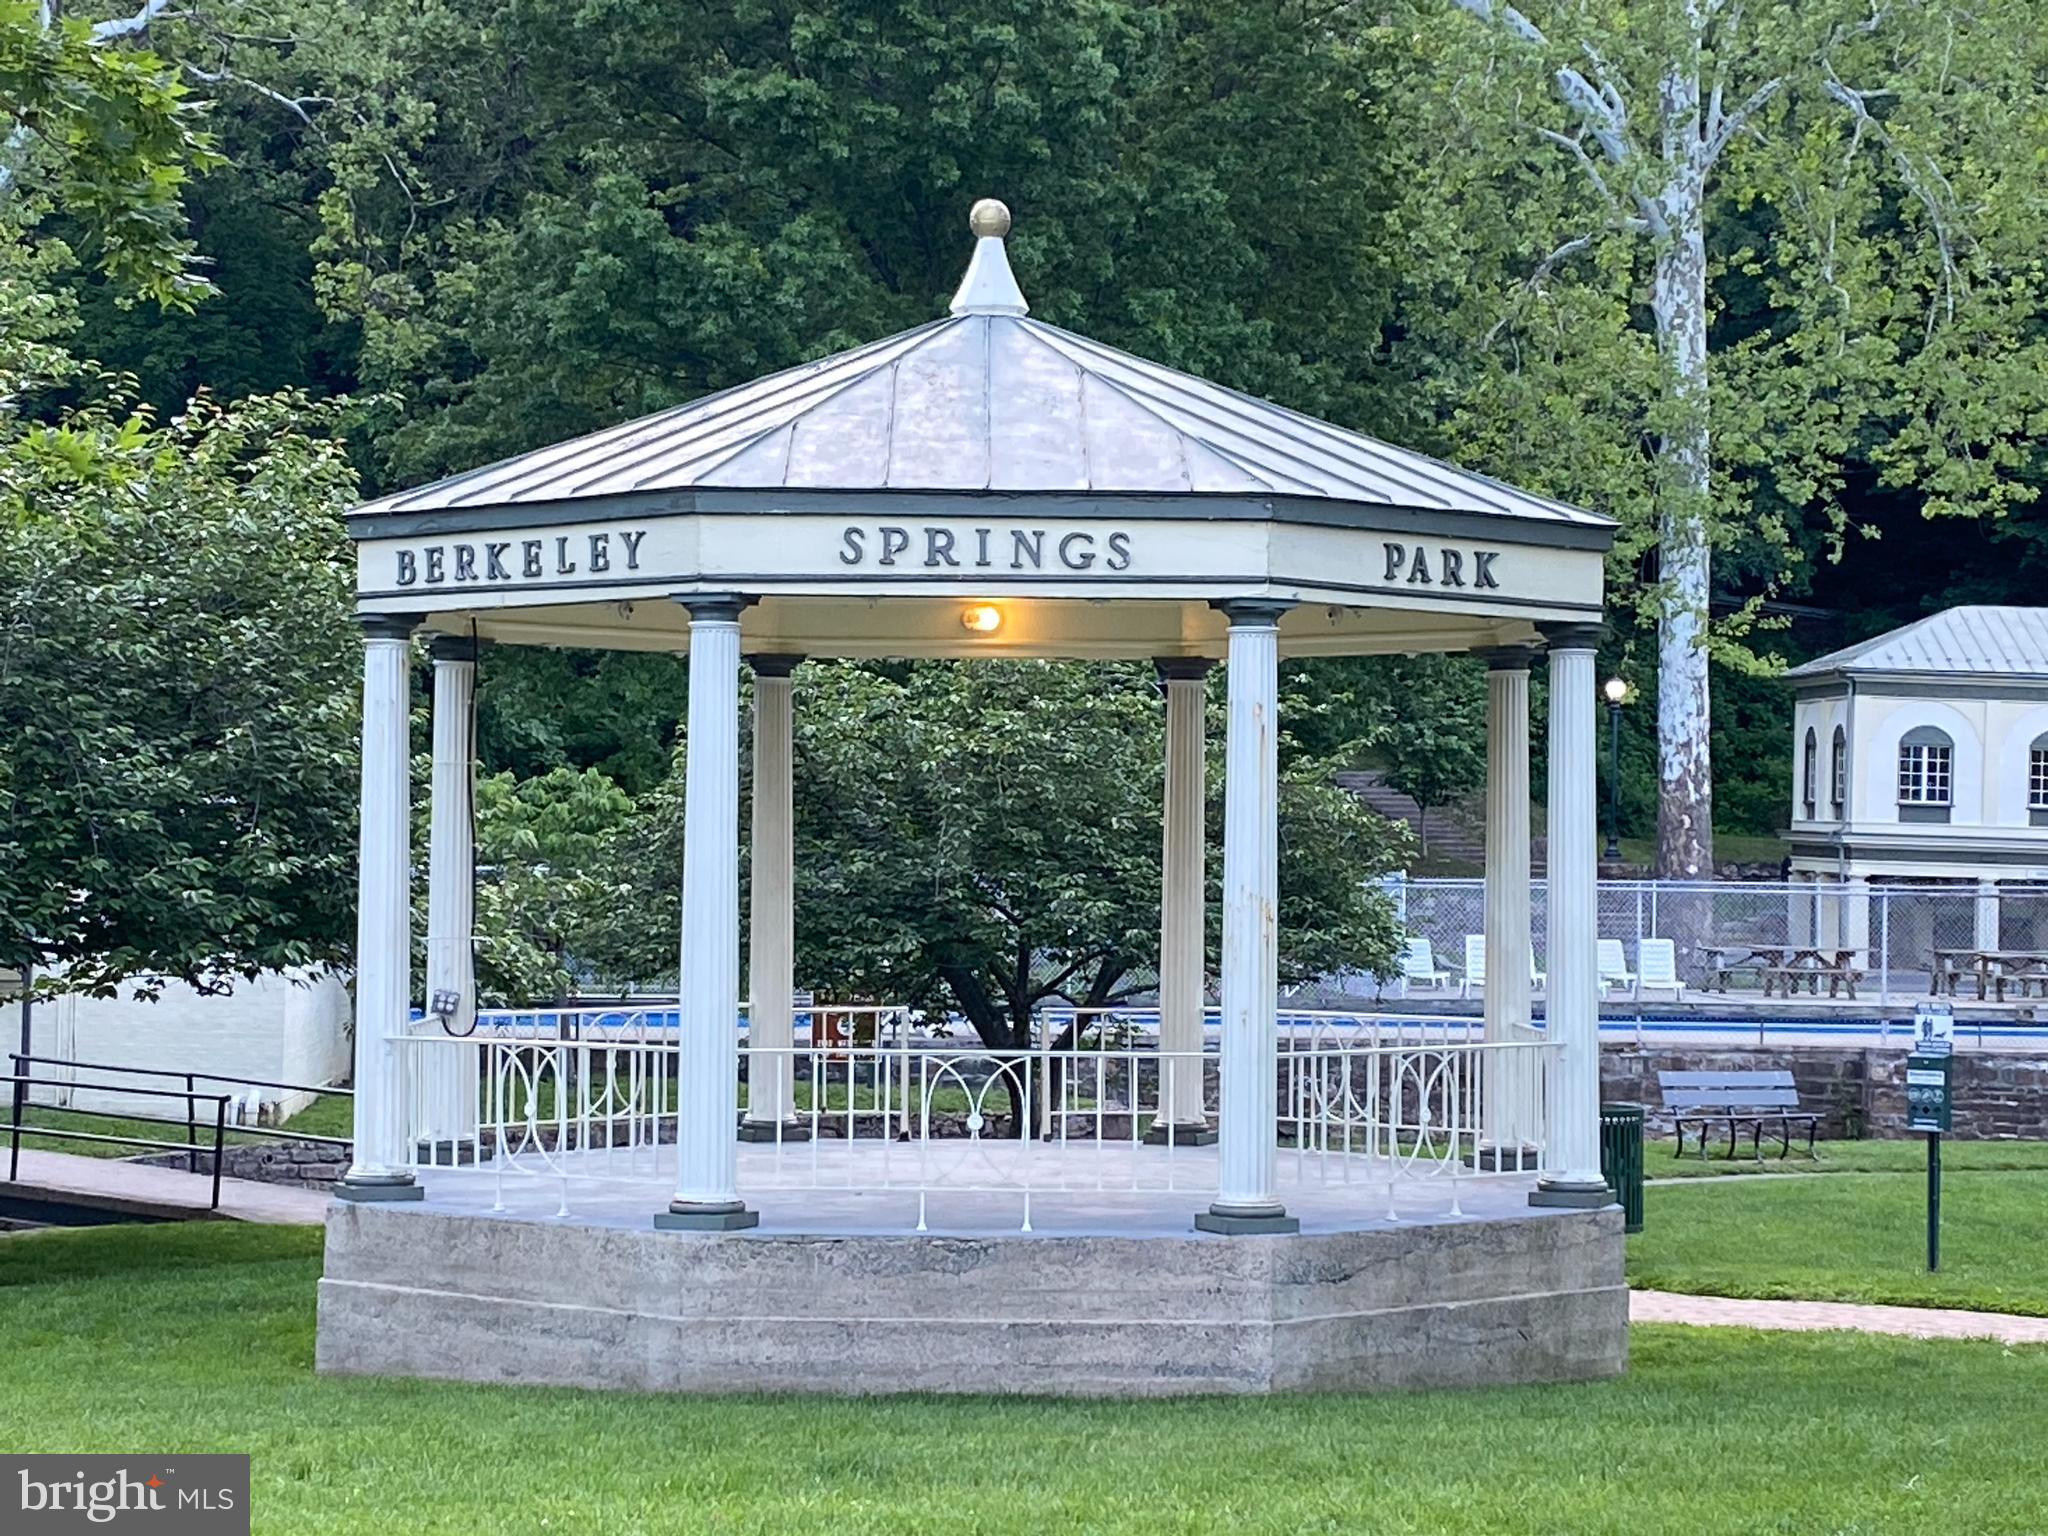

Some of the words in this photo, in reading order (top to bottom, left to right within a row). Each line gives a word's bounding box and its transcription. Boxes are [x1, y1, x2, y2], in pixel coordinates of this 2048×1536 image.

[396, 531, 647, 586] BERKELEY
[839, 526, 1132, 571] SPRINGS
[1383, 542, 1501, 589] PARK
